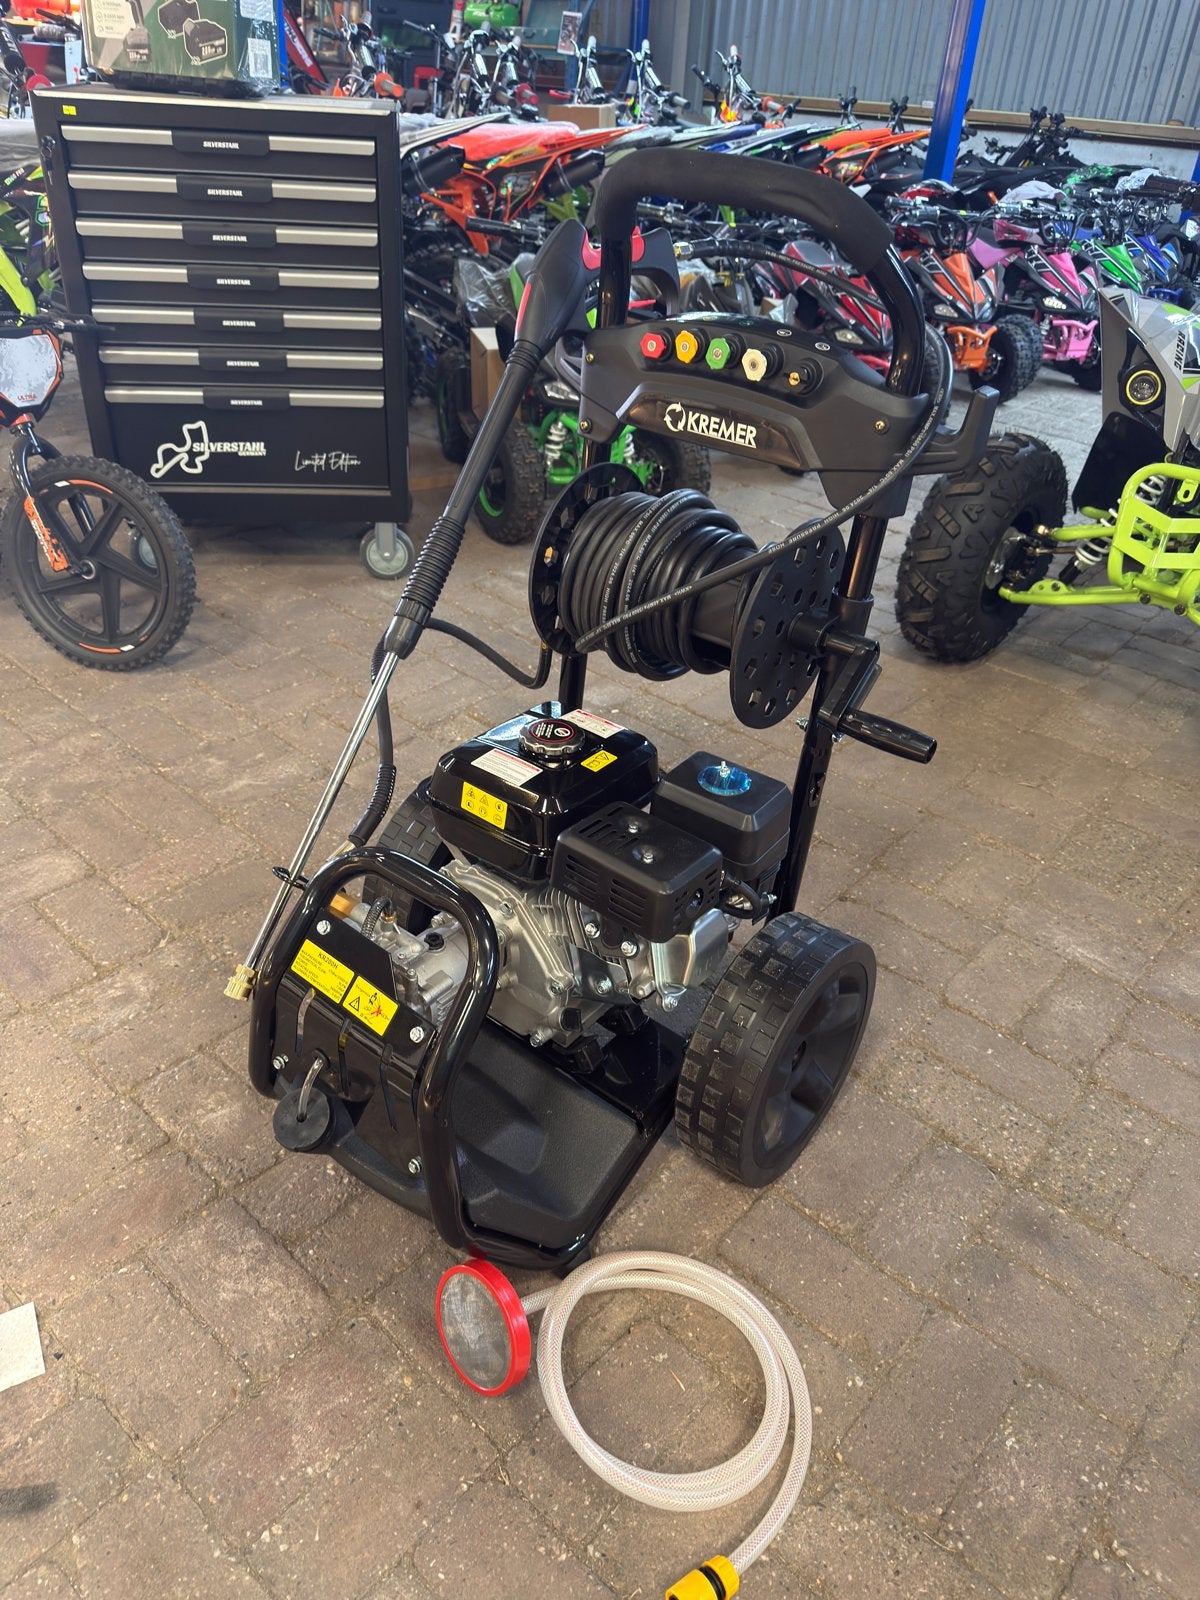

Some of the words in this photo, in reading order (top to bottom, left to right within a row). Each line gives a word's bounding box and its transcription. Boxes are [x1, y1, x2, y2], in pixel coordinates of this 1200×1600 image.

[203, 141, 239, 149] SILVERSTAHL
[207, 189, 243, 197] SILVERSTAHL
[212, 234, 248, 242] SILVERSTAHL
[216, 278, 251, 286] SILVERSTAHL
[1172, 330, 1185, 371] RACING
[687, 411, 757, 448] KREMER
[192, 442, 266, 453] SILVERSTAHL
[294, 451, 327, 473] Limited
[328, 451, 362, 473] Edition
[824, 512, 840, 524] HIGH
[789, 523, 821, 543] PRESSURE
[767, 541, 785, 554] HOSE
[317, 951, 338, 969] KR200H
